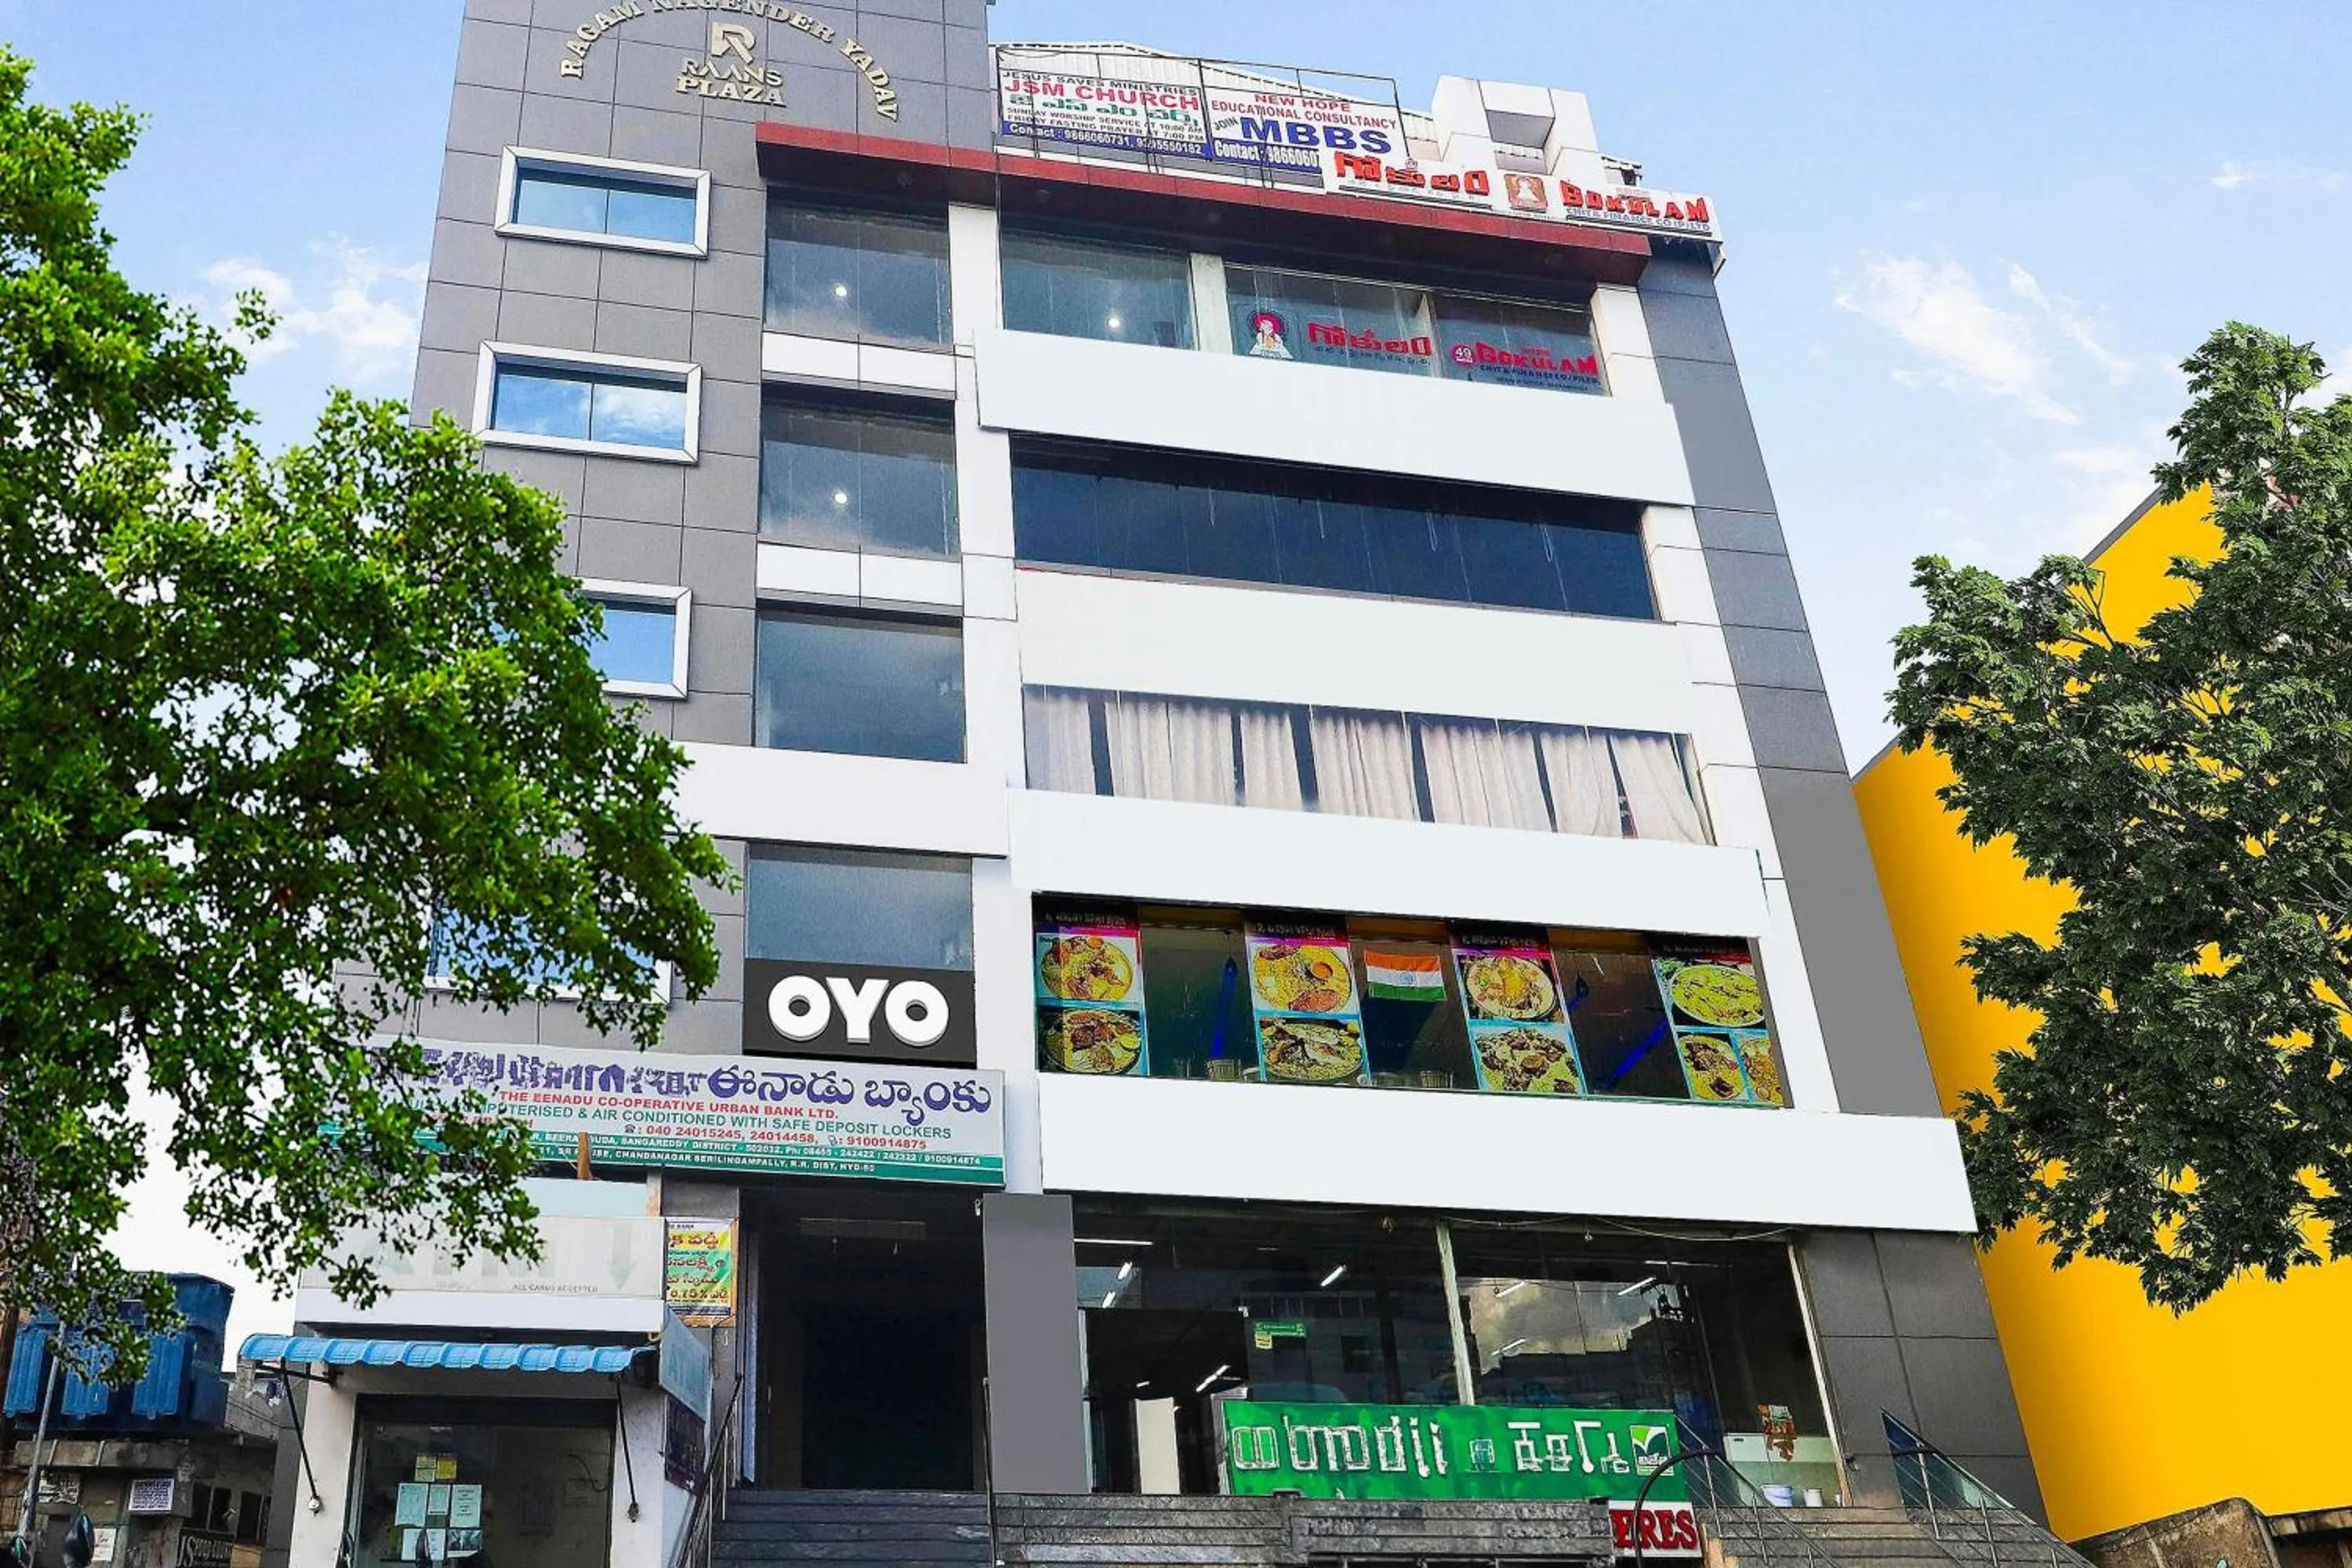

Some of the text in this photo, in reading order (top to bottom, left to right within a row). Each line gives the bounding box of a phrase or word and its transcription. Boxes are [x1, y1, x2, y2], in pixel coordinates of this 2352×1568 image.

[561, 1, 644, 79] RAGAM
[839, 38, 902, 122] YADAV
[677, 77, 786, 107] PLAZA
[1004, 71, 1197, 96] JESUS SAVES MINISTRIES
[1004, 79, 1199, 110] JSM CHURCH
[1007, 107, 1047, 117] SUNDAY
[1051, 112, 1096, 122] WORSHIP
[1099, 117, 1141, 127] SERVICE
[1211, 100, 1396, 129] EDUCATIONAL CONSULTANCY
[1255, 95, 1351, 111] NEW HOPE
[1009, 123, 1054, 137] Conact
[1051, 120, 1097, 129] FASTING
[1100, 125, 1142, 133] PRAYER
[1214, 115, 1392, 154] JOIN MBBS
[768, 975, 950, 1047] OYO
[499, 1091, 839, 1120] THE EENADU CO-OPERATIVE URBAN BANK LTD.
[707, 1064, 855, 1105] ఈనాడు
[864, 1080, 992, 1127] బ్యాంకు
[578, 1107, 588, 1119] &
[592, 1108, 617, 1120] AIR
[622, 1110, 726, 1127] CONDITIONED
[731, 1115, 768, 1128] WITH
[772, 1119, 810, 1131] SAFE
[815, 1121, 878, 1134] DEPOSIT
[883, 1125, 951, 1138] LOCKERS
[647, 1125, 671, 1135] 040
[676, 1127, 745, 1140] 24015245,
[750, 1130, 818, 1144] 24014458,
[615, 1150, 691, 1162] CHANDANAGAR
[621, 1137, 688, 1149] SANGAREDDY
[692, 1142, 735, 1152] DISTRICT
